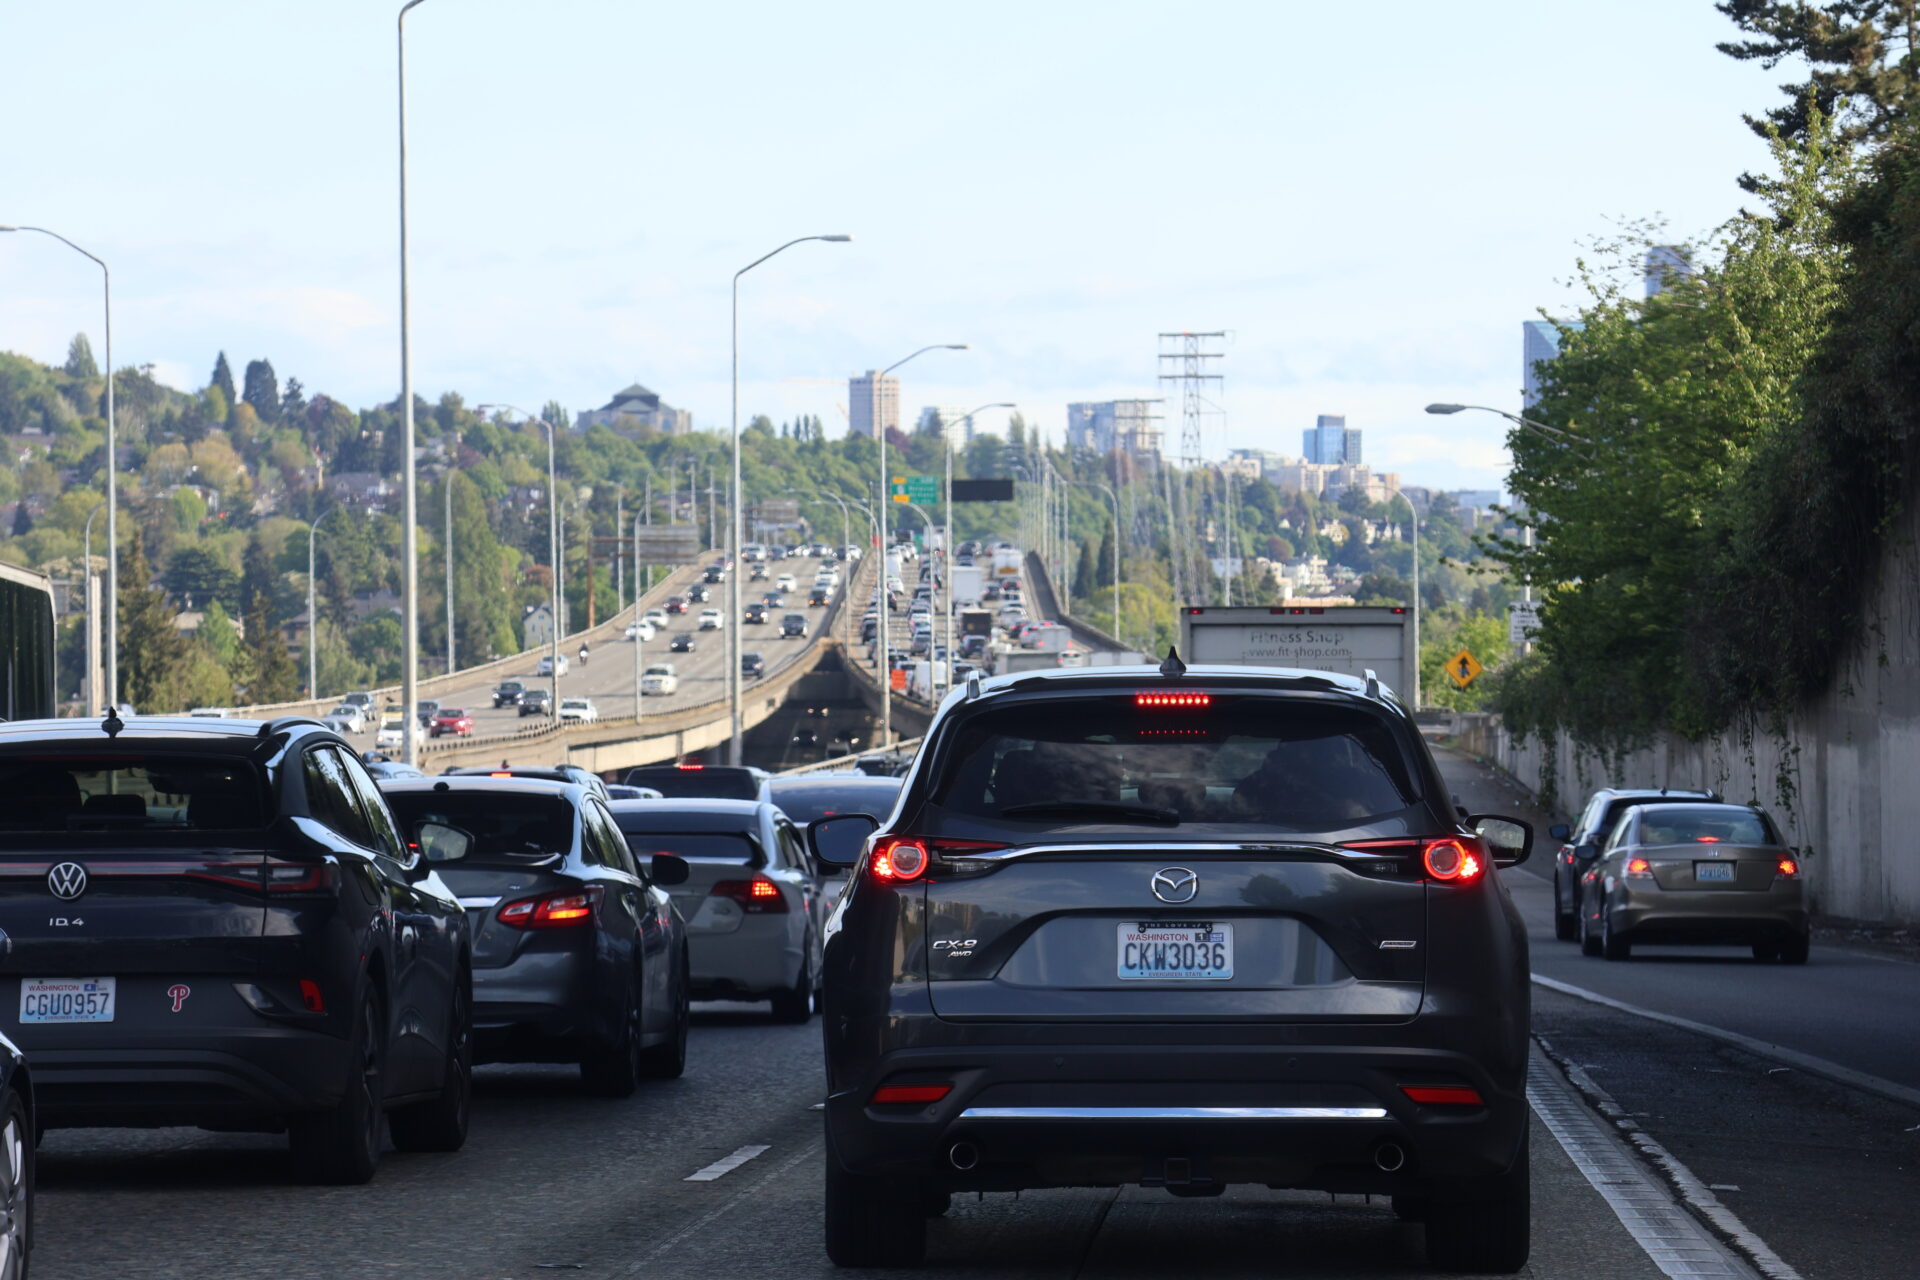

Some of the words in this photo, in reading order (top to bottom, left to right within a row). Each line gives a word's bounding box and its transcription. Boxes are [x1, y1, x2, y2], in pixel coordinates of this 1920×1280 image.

[1250, 631, 1302, 643] Fitness
[1126, 933, 1189, 941] WASHINGTON
[932, 939, 978, 950] CX-9
[947, 950, 973, 958] AWD
[1124, 942, 1225, 970] CKW3036
[28, 984, 80, 992] WASHINGTON
[167, 984, 190, 1012] P
[26, 992, 110, 1016] CGU0957
